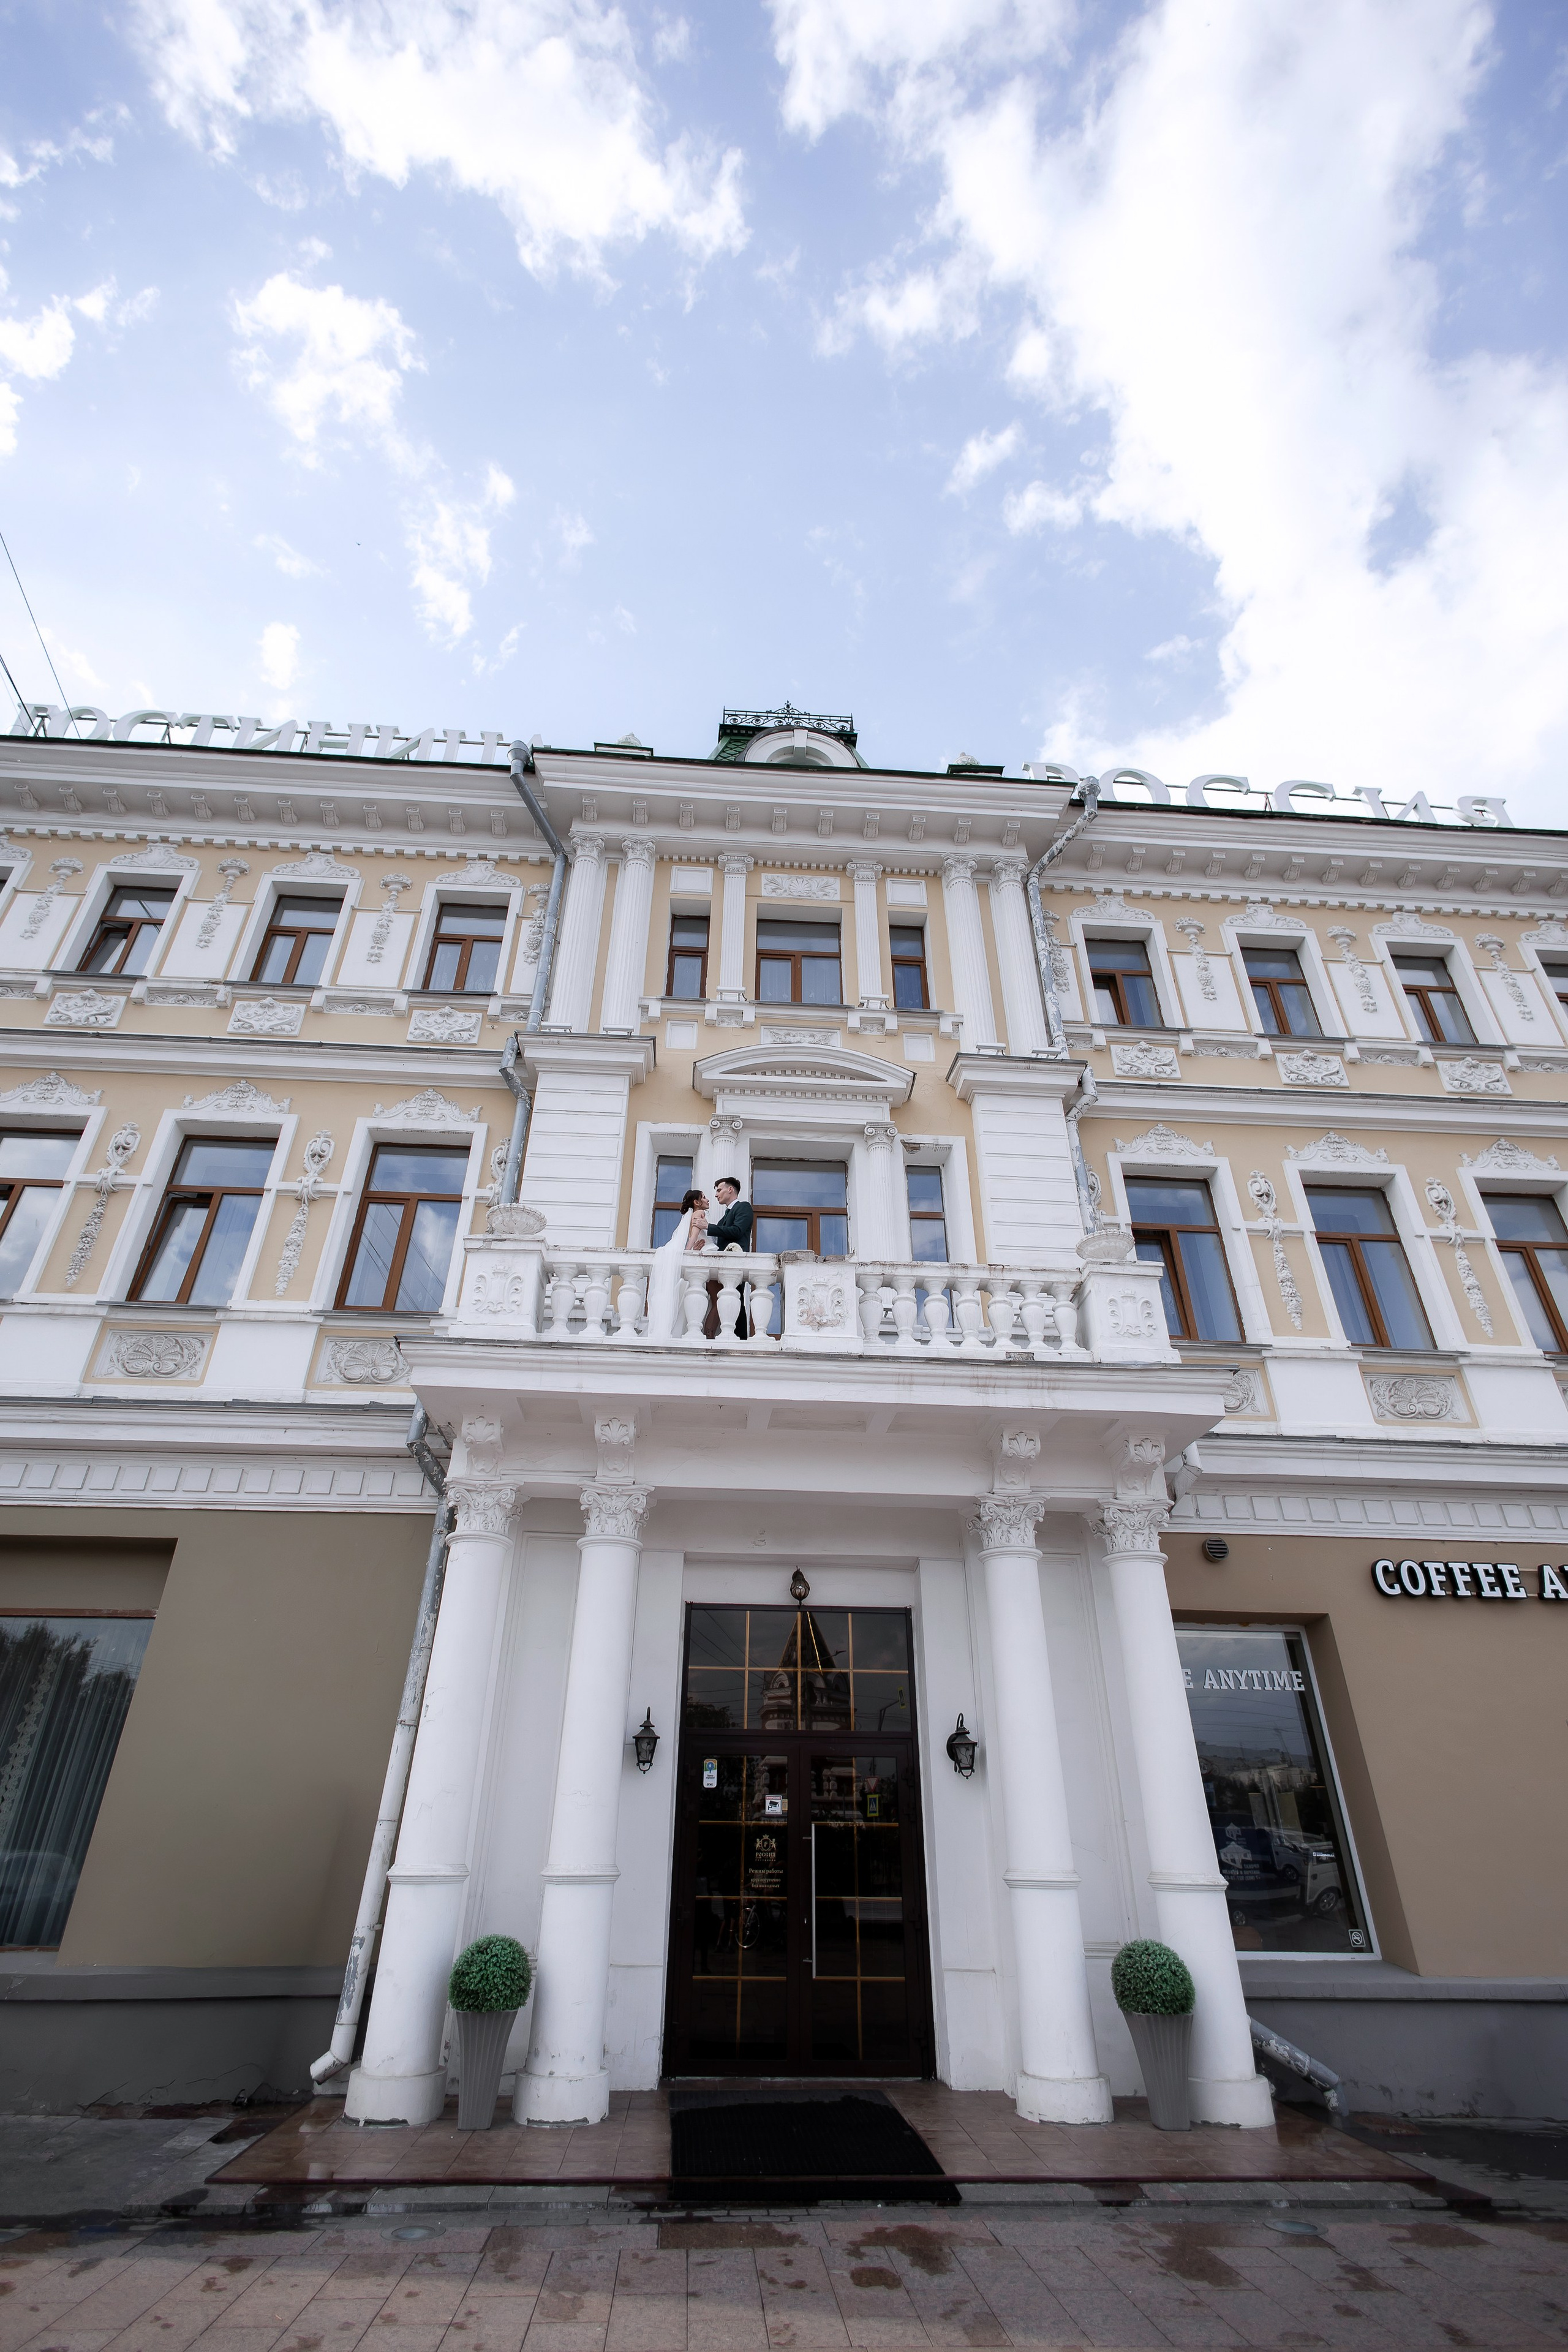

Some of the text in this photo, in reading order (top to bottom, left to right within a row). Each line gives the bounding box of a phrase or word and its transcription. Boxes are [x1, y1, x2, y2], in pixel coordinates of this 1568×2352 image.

[9, 703, 544, 764] ГОСТИНИЦ
[1372, 1559, 1568, 1600] COFFEE A
[1203, 1669, 1305, 1691] ANYTIME
